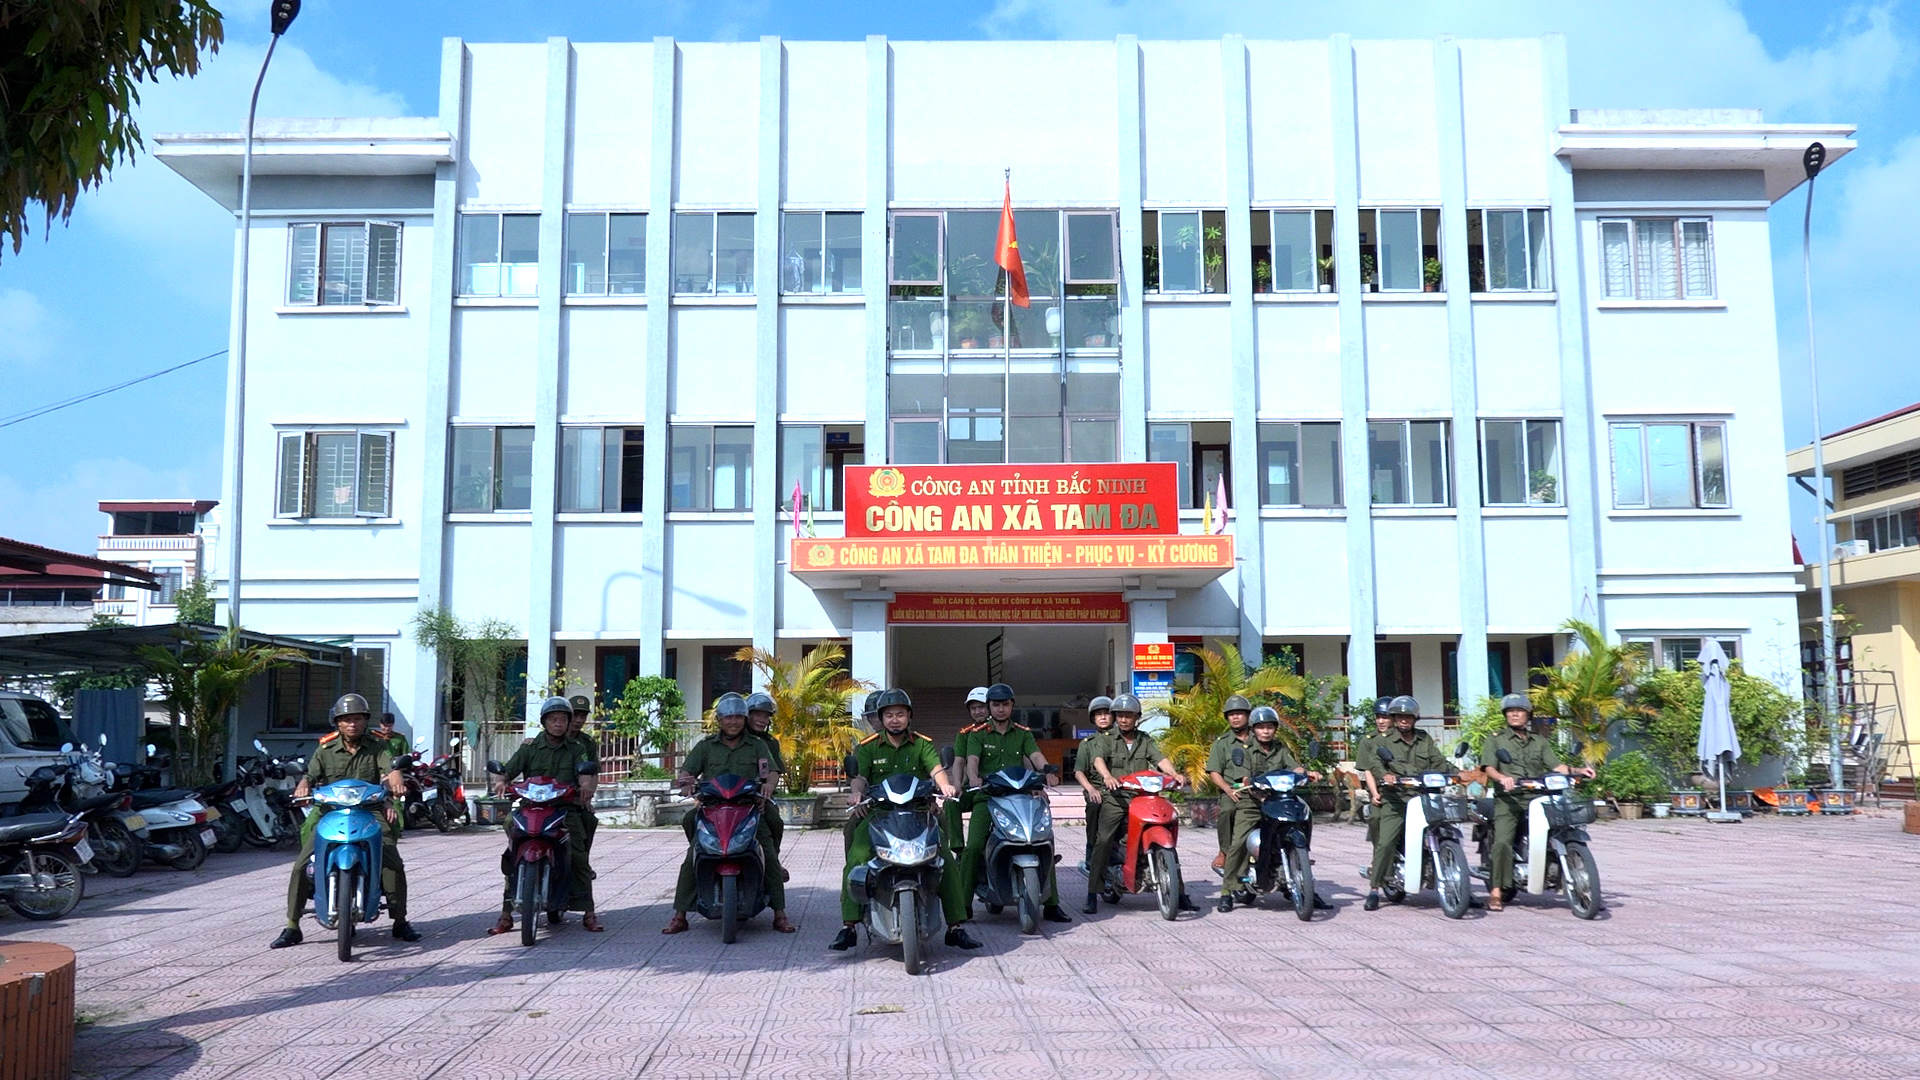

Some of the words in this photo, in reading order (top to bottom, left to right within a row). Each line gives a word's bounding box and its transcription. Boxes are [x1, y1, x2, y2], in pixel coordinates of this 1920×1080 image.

[911, 475, 963, 496] CÔNG
[967, 480, 995, 495] AN
[1000, 472, 1050, 495] TỈNH
[1056, 470, 1091, 495] BẮC
[1097, 478, 1147, 494] NINH
[866, 499, 943, 532] CÔNG
[951, 504, 993, 531] AN
[1002, 498, 1043, 531] XÃ
[1050, 504, 1111, 531] TAM
[1119, 503, 1159, 530] ĐA
[840, 544, 878, 566] CÔNG
[881, 546, 902, 565] AN
[905, 543, 924, 565] XÃ
[927, 546, 956, 564] TAM
[959, 546, 979, 564] ĐA
[982, 541, 1018, 564] THÂN
[1022, 541, 1062, 567] THIỆN
[1075, 545, 1113, 567] PHỤC
[1116, 545, 1135, 567] VỤ
[1147, 539, 1166, 563] KỶ
[1170, 542, 1218, 563] CƯƠNG
[1010, 597, 1030, 605] CÔNG
[1043, 597, 1053, 605] XÃ
